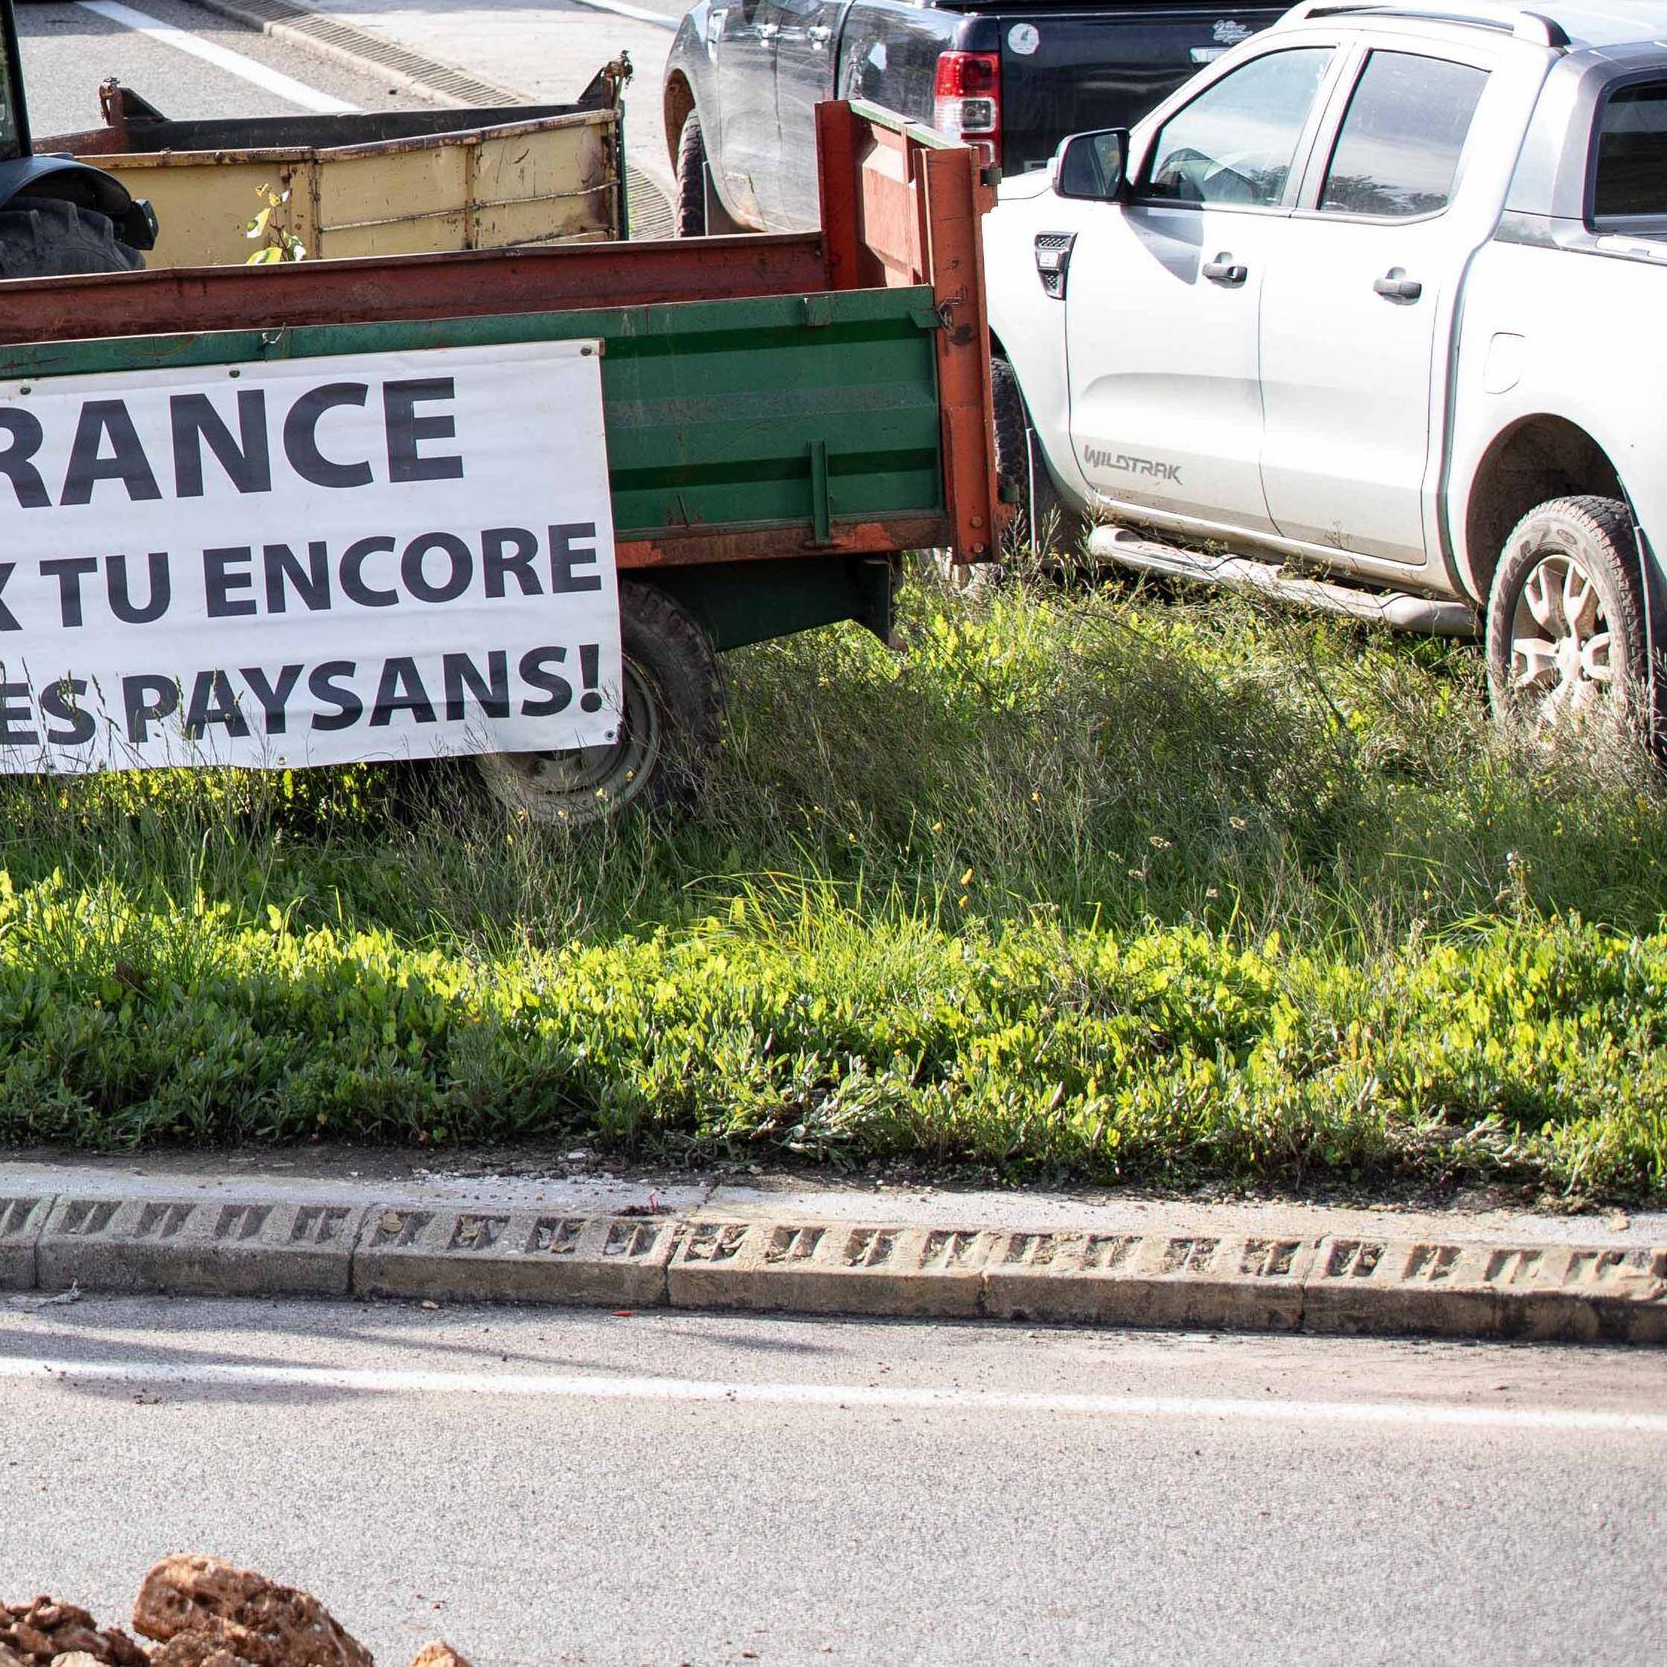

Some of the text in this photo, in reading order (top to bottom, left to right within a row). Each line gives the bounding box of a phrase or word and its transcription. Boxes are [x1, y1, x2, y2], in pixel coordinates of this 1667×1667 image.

[1083, 444, 1183, 485] WILDTRAK
[40, 551, 170, 629] TU
[203, 522, 602, 619] ENCORE
[124, 643, 602, 743] PAYSANS!
